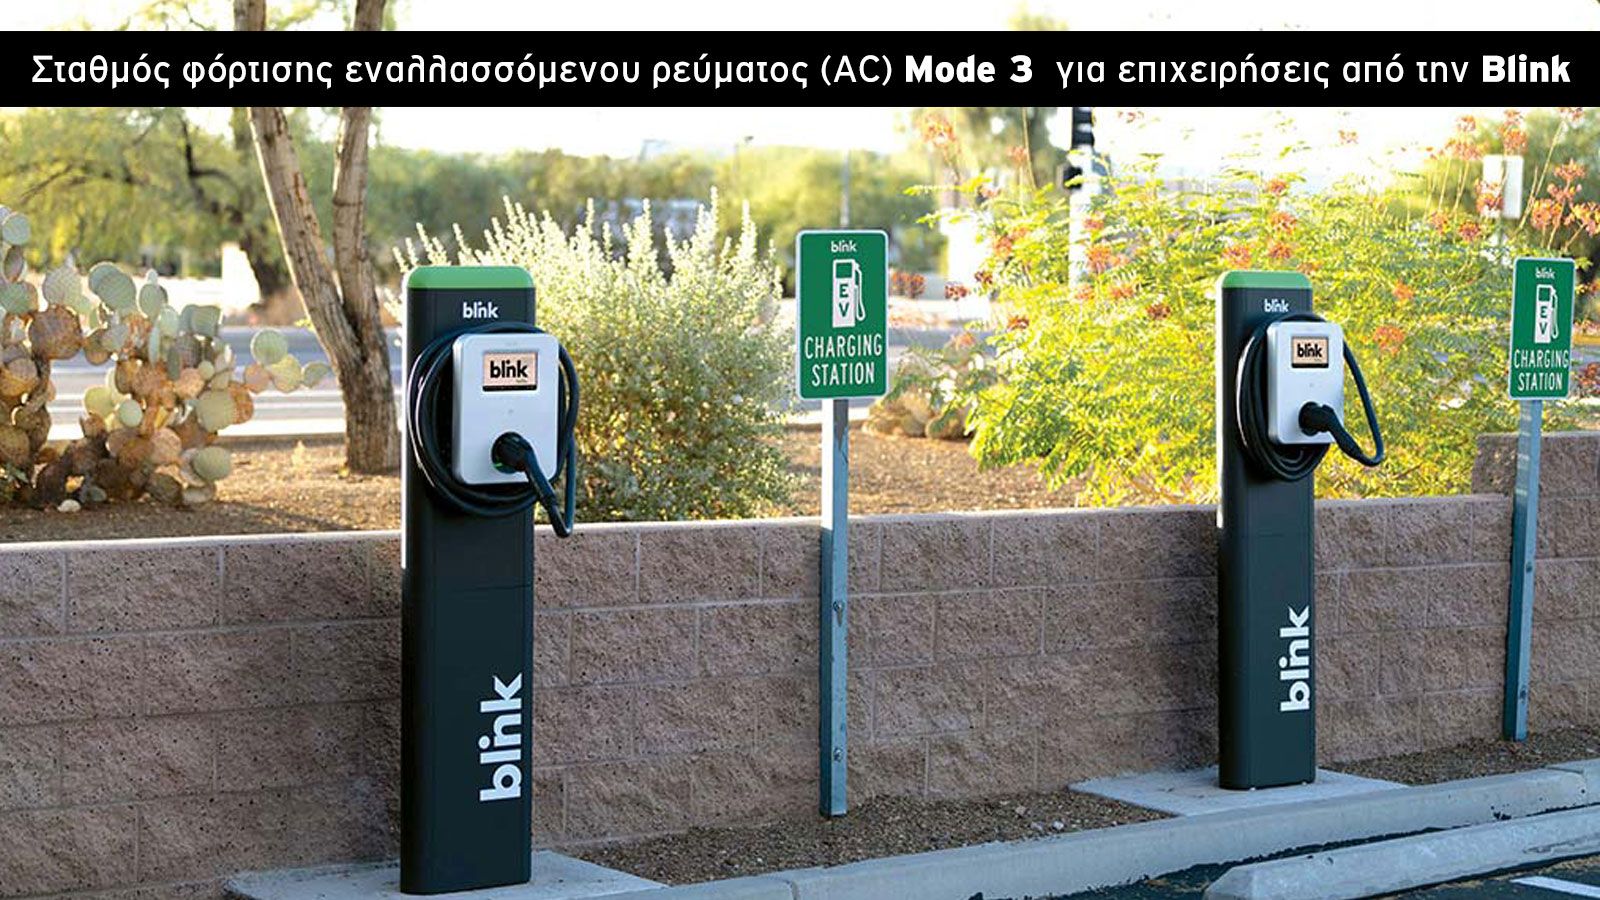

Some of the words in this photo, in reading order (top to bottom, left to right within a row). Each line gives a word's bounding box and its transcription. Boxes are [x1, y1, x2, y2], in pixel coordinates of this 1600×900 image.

[831, 239, 857, 253] blink
[462, 301, 499, 319] blink
[1264, 298, 1289, 313] blink
[804, 334, 883, 359] CHARGING
[1297, 343, 1323, 358] blink
[490, 359, 528, 379] blink
[1514, 349, 1569, 369] CHARGING
[811, 362, 875, 387] STATION
[1517, 372, 1563, 391] STATION
[1278, 606, 1311, 712] blink
[479, 673, 522, 801] blink
